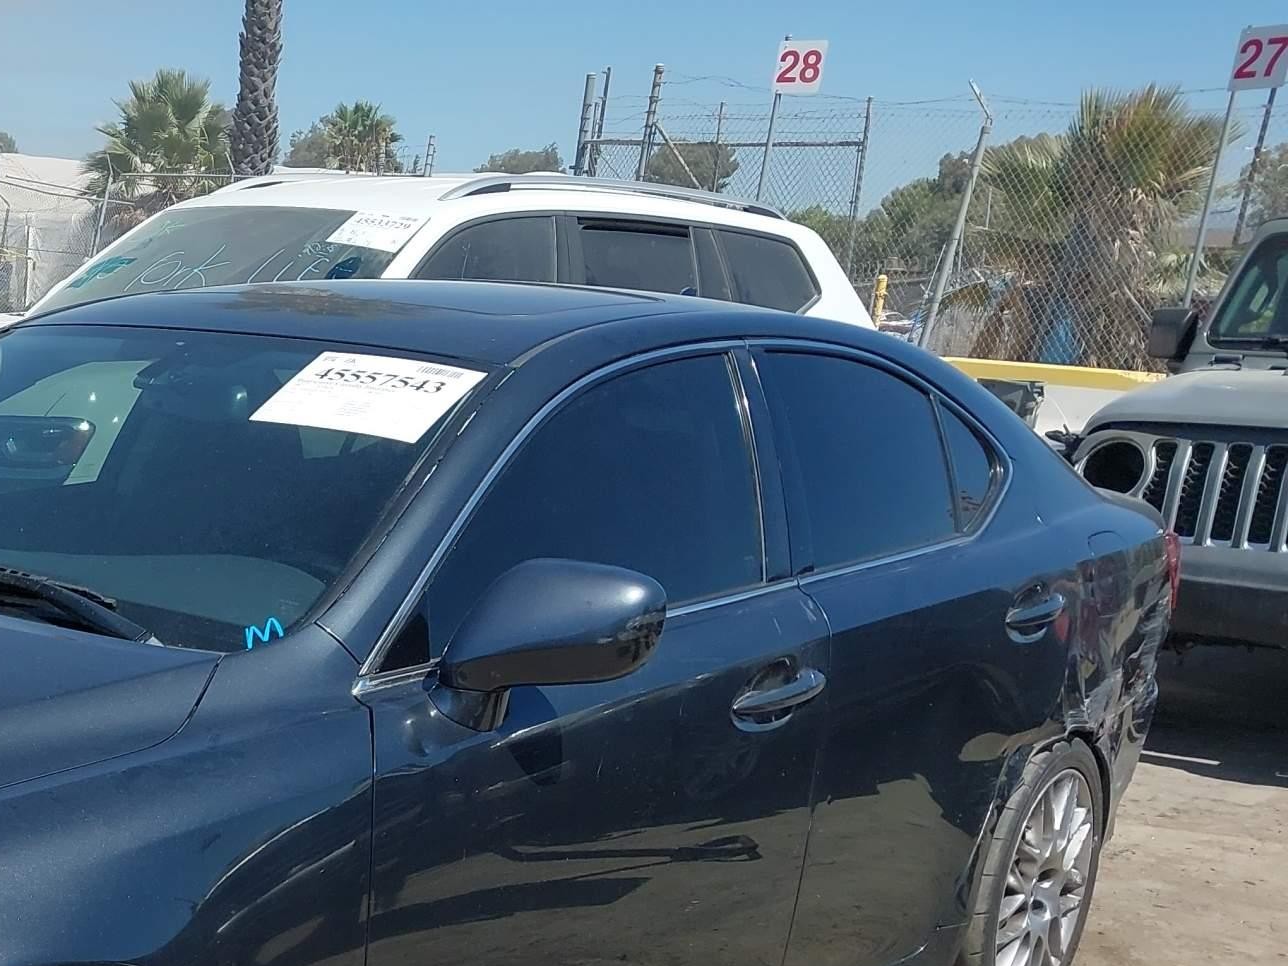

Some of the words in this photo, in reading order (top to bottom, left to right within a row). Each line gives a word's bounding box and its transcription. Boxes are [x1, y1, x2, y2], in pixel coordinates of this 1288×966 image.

[776, 49, 822, 83] 28
[1234, 36, 1288, 79] 27
[314, 367, 447, 394] 45557543
